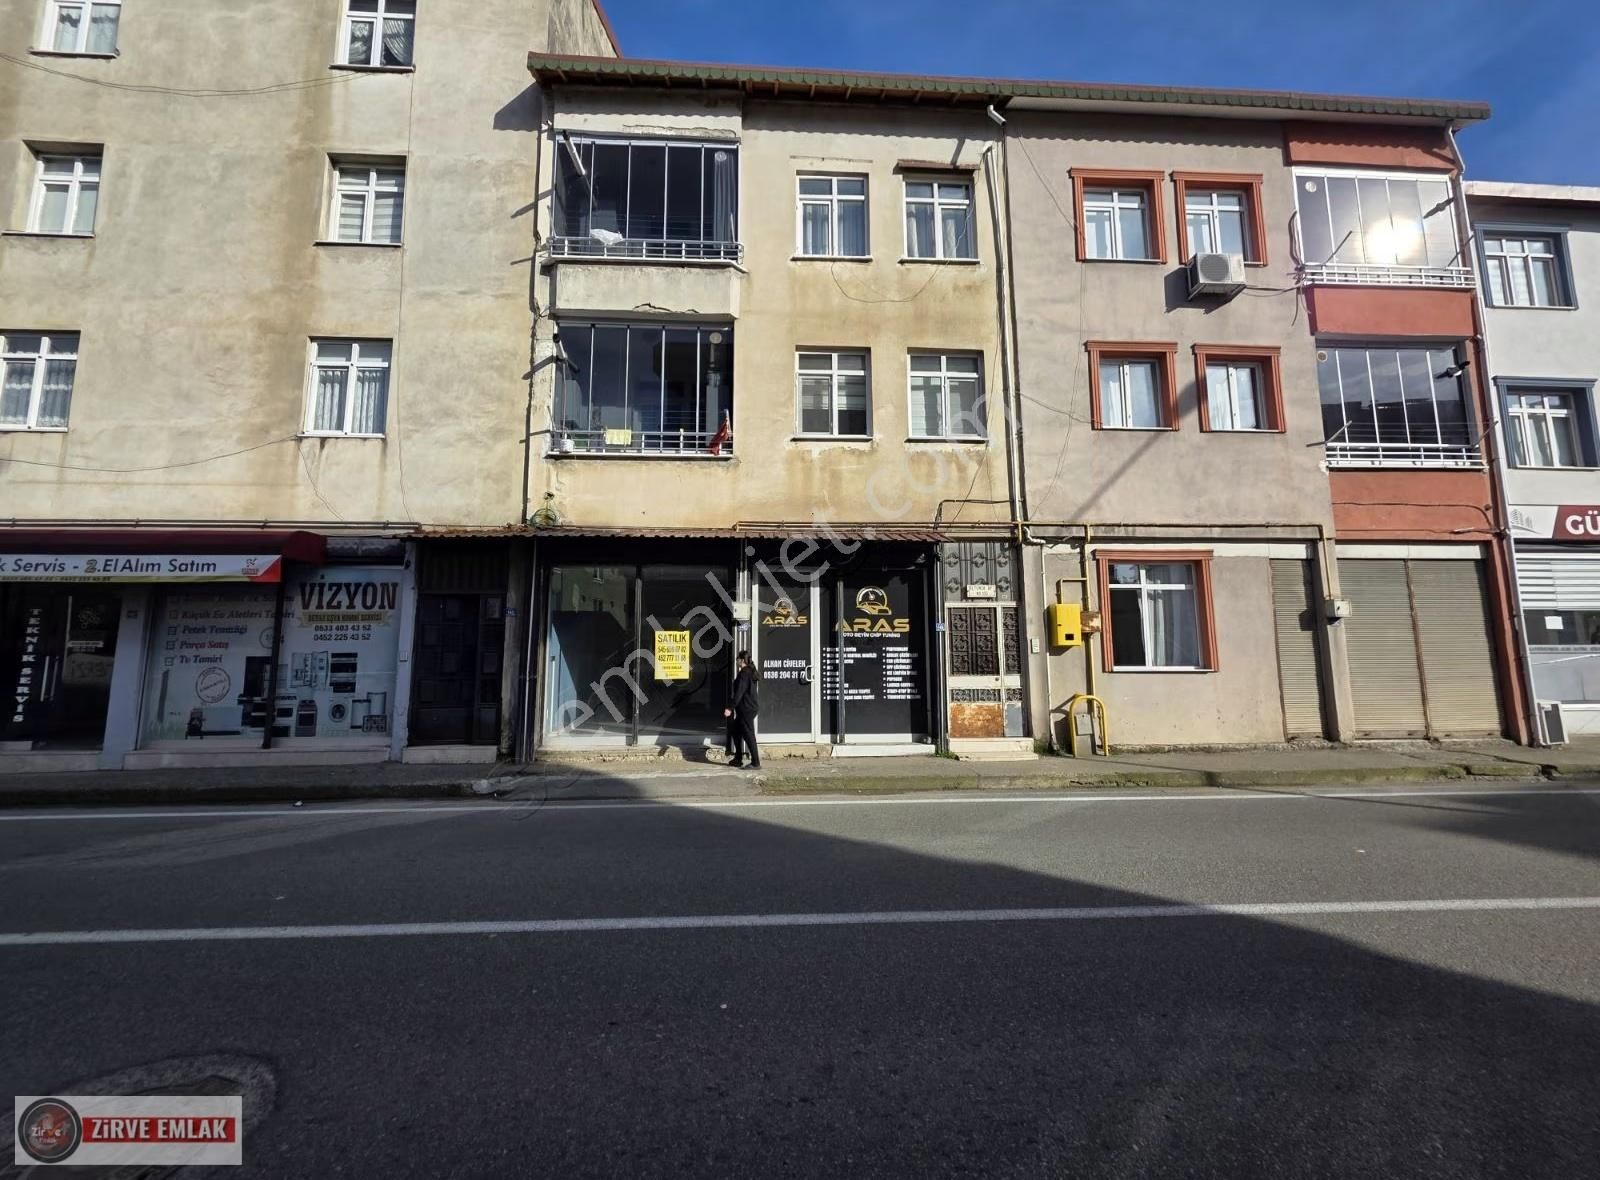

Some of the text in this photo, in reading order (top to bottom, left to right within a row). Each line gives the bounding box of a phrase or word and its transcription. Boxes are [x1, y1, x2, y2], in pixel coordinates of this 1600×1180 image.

[1565, 510, 1600, 535] GÜ
[12, 558, 66, 573] Servis
[120, 558, 161, 573] Alım
[168, 559, 217, 573] Satım
[299, 574, 399, 610] VİZYON
[762, 616, 808, 625] ARAS
[834, 618, 910, 632] ARAS
[657, 633, 687, 643] SATILIK
